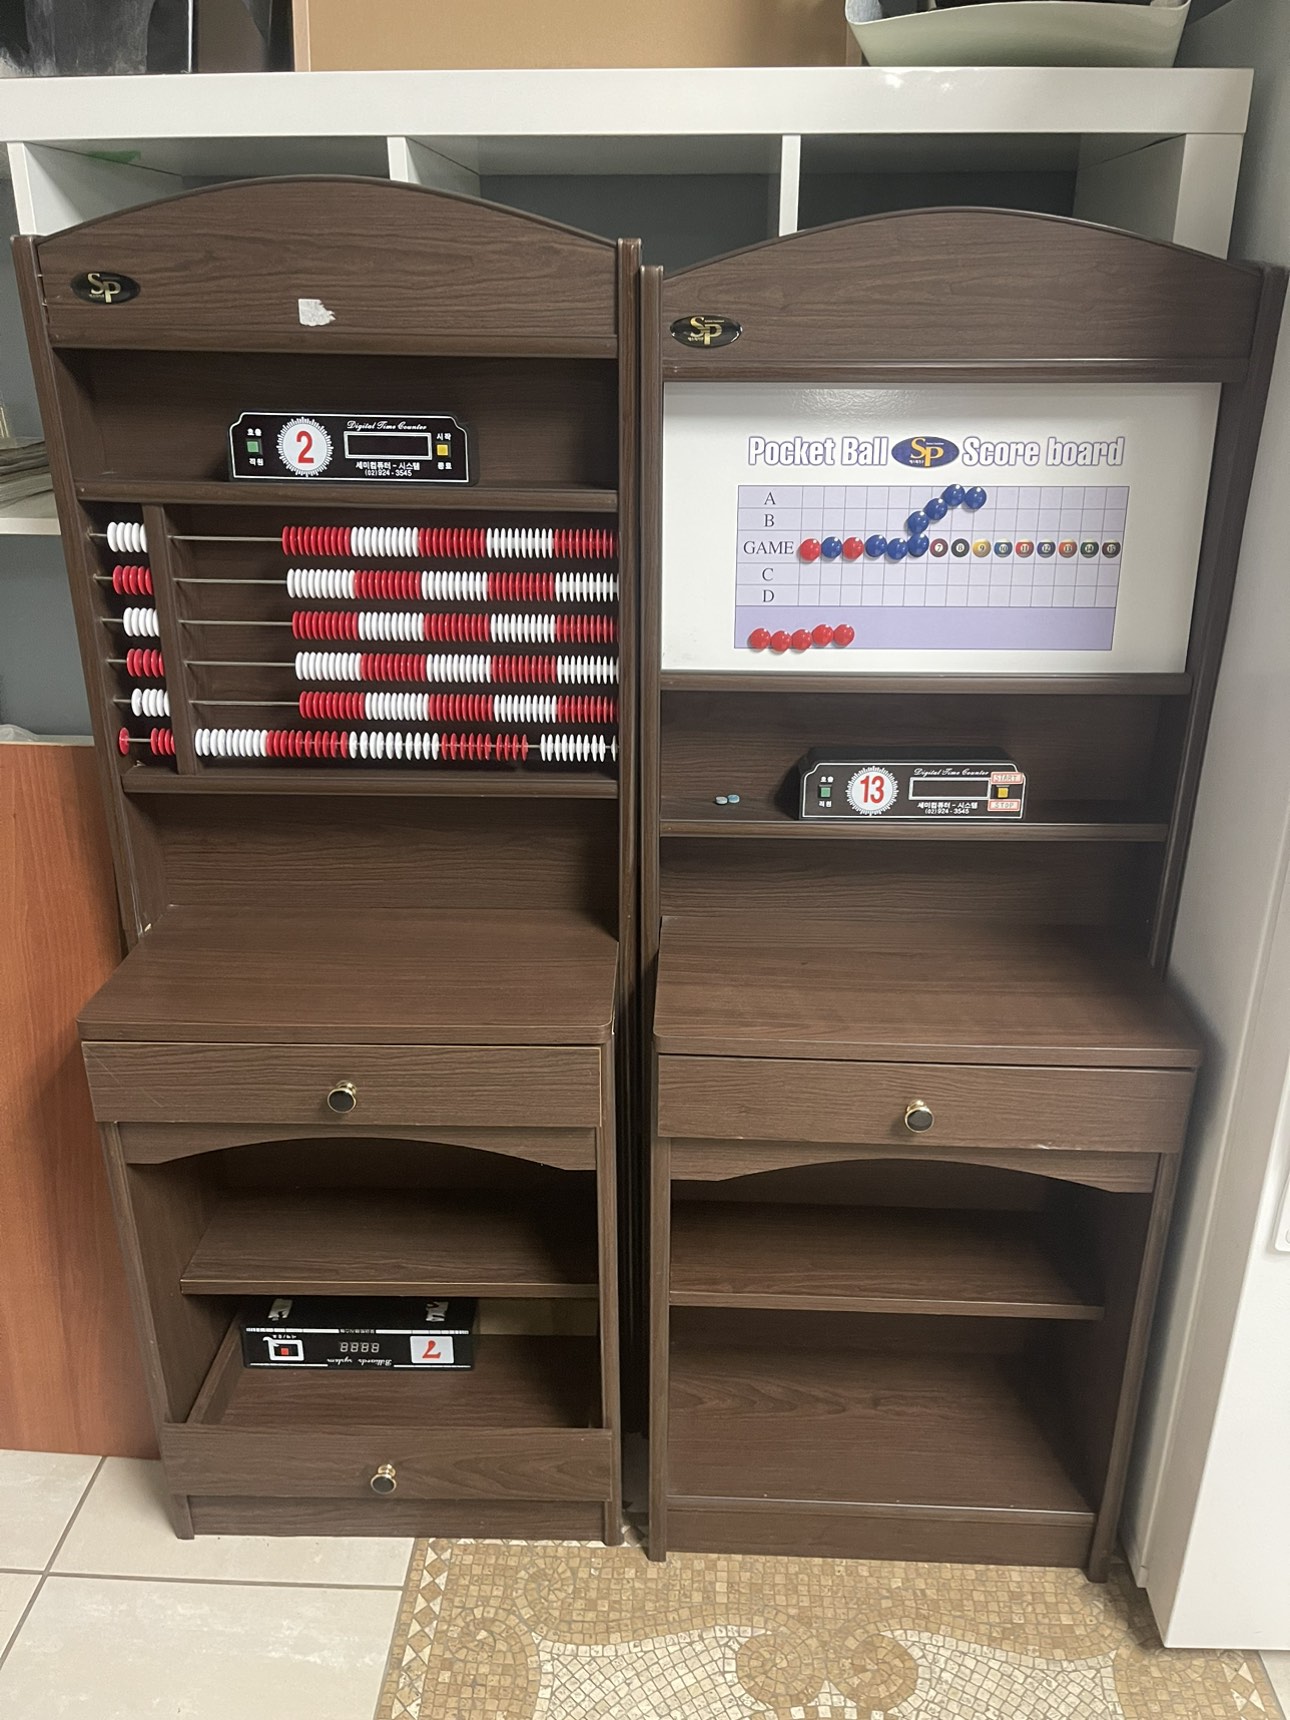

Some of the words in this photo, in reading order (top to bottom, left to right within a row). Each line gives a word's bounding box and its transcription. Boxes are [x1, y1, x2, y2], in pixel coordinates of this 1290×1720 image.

[87, 272, 121, 303] SP
[690, 316, 723, 345] SP
[346, 420, 375, 431] Digital
[377, 420, 396, 430] Time
[397, 421, 427, 430] Counter
[436, 432, 452, 441] 시작
[296, 430, 314, 464] 2
[747, 436, 836, 466] Pocket
[840, 436, 889, 466] Ball
[961, 435, 1041, 467] Score
[1045, 436, 1126, 467] board
[398, 461, 420, 470] 시스템
[763, 491, 777, 506] A
[763, 513, 775, 527] B
[743, 540, 795, 555] GAME
[761, 567, 774, 582] C
[762, 589, 775, 603] D
[913, 767, 942, 778] Digital
[942, 767, 960, 776] Time
[961, 768, 989, 776] Counter
[994, 774, 1018, 783] START
[860, 775, 885, 804] 13
[994, 802, 1015, 810] STOP
[422, 1339, 441, 1359] 7
